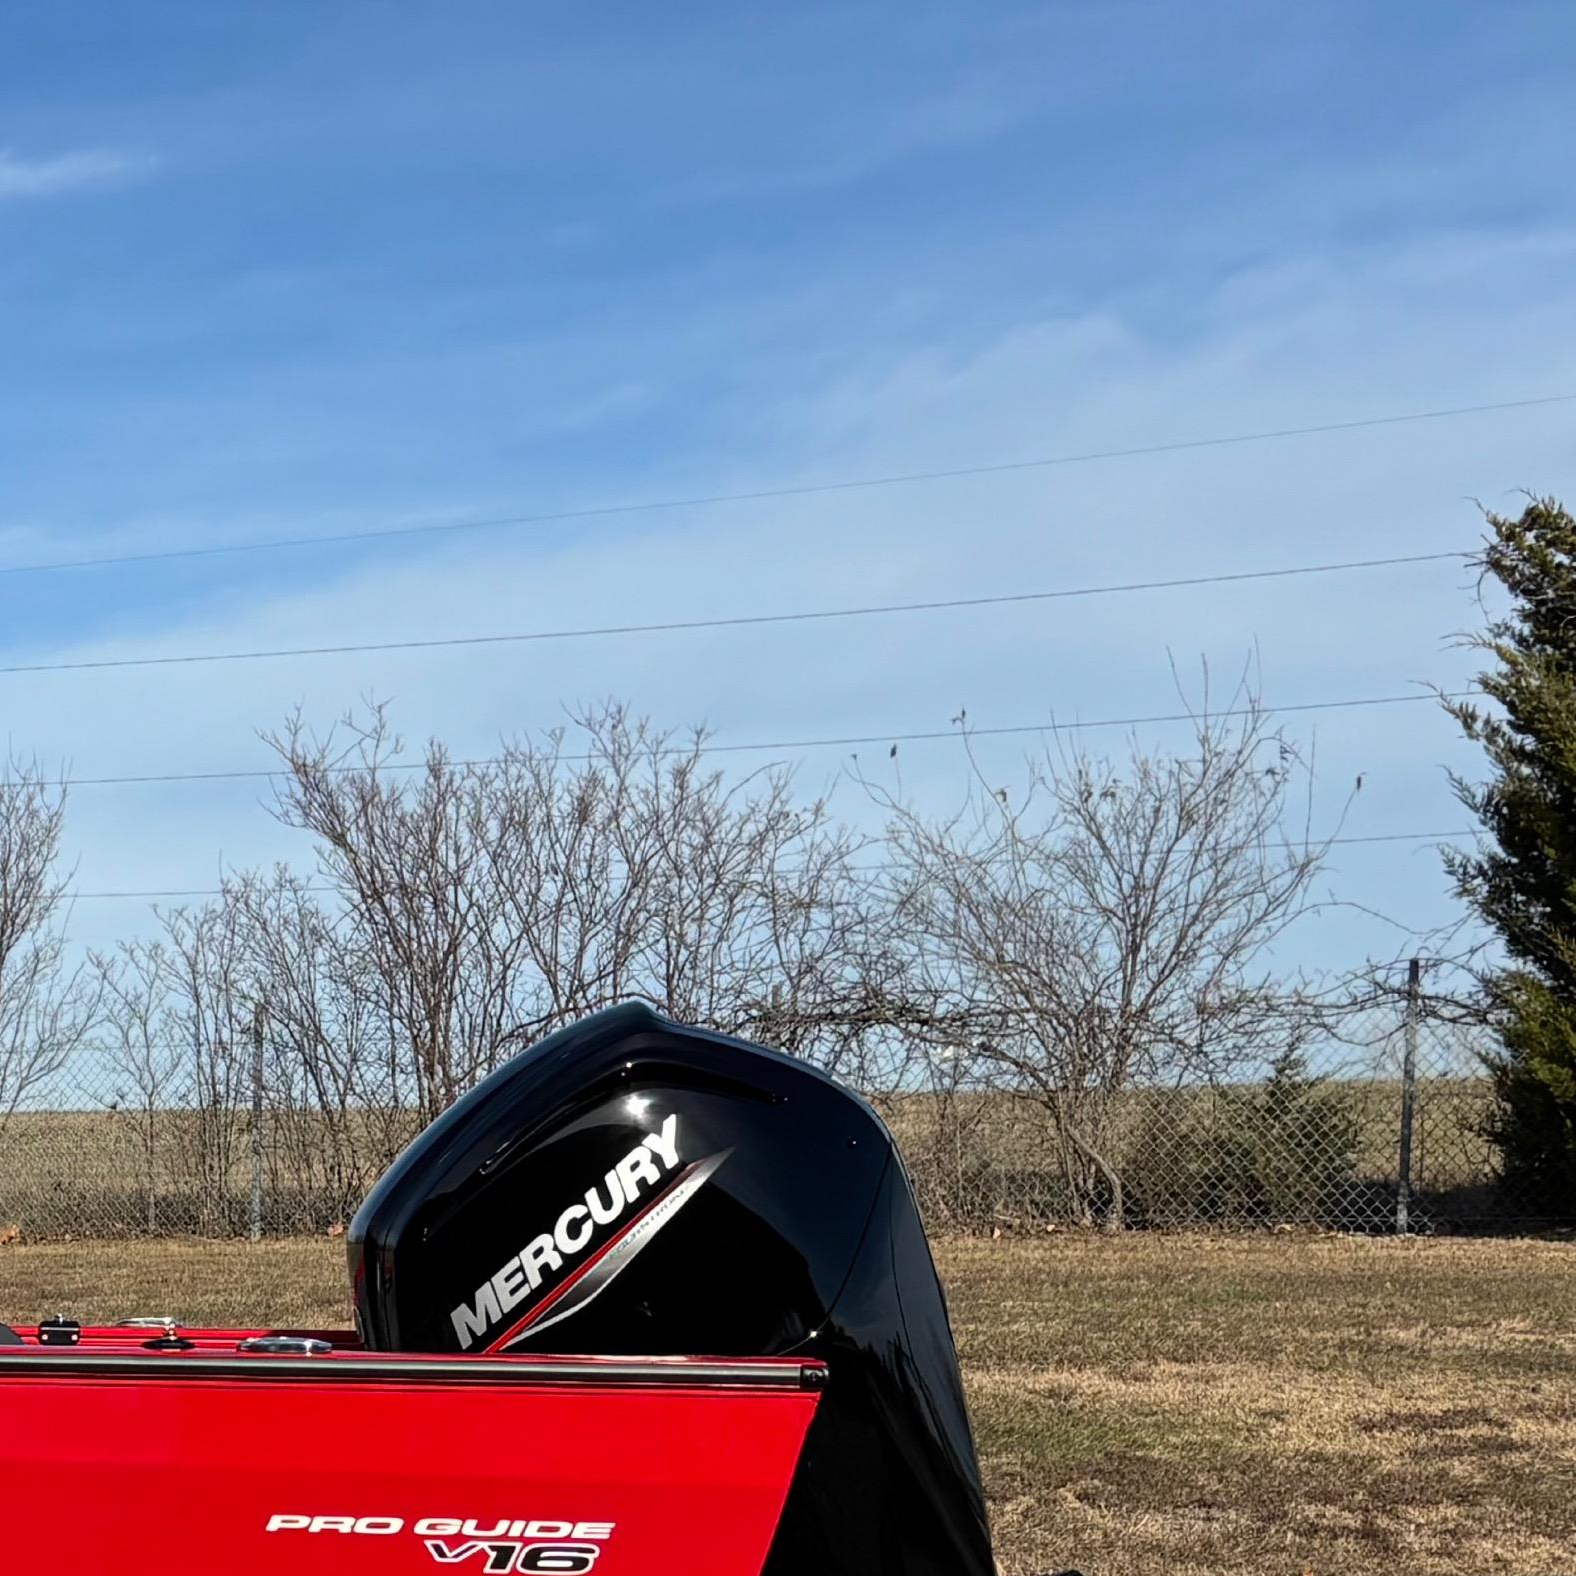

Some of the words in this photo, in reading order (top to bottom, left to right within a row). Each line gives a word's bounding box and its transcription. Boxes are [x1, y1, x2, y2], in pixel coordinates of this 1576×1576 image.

[450, 1113, 681, 1350] MERCURY
[265, 1514, 405, 1535] PRO
[413, 1518, 616, 1540] GUIDE
[423, 1539, 601, 1576] V16
